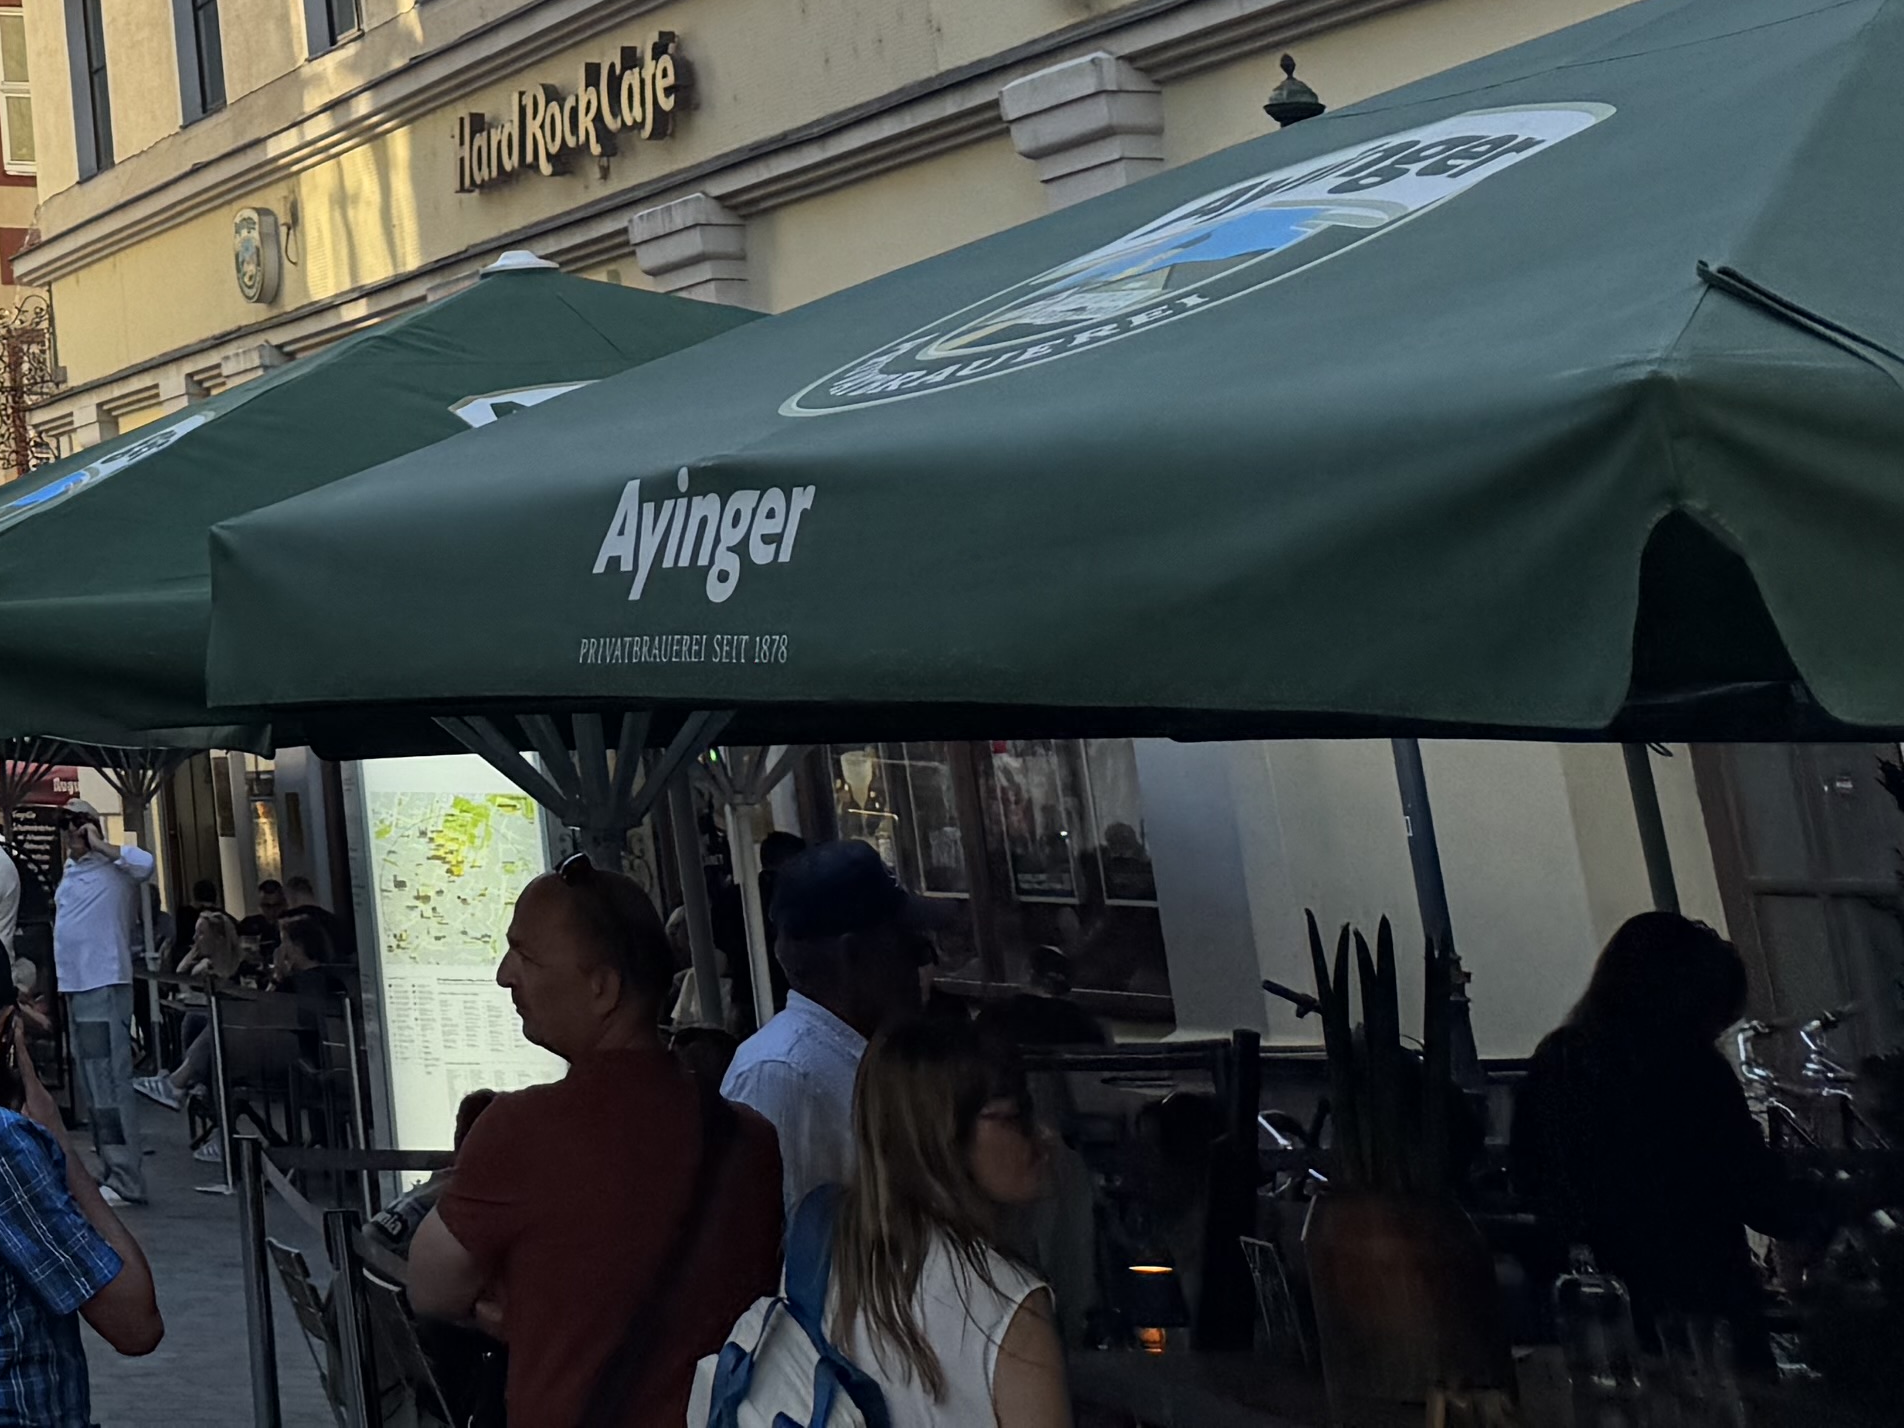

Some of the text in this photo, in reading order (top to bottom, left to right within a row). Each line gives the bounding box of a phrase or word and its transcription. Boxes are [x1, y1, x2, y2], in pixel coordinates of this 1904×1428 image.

[456, 91, 520, 193] Hard
[521, 61, 602, 177] Rock
[592, 466, 817, 604] Ayinger
[579, 634, 788, 664] PRIVATBRAUEREI SEIT 1878
